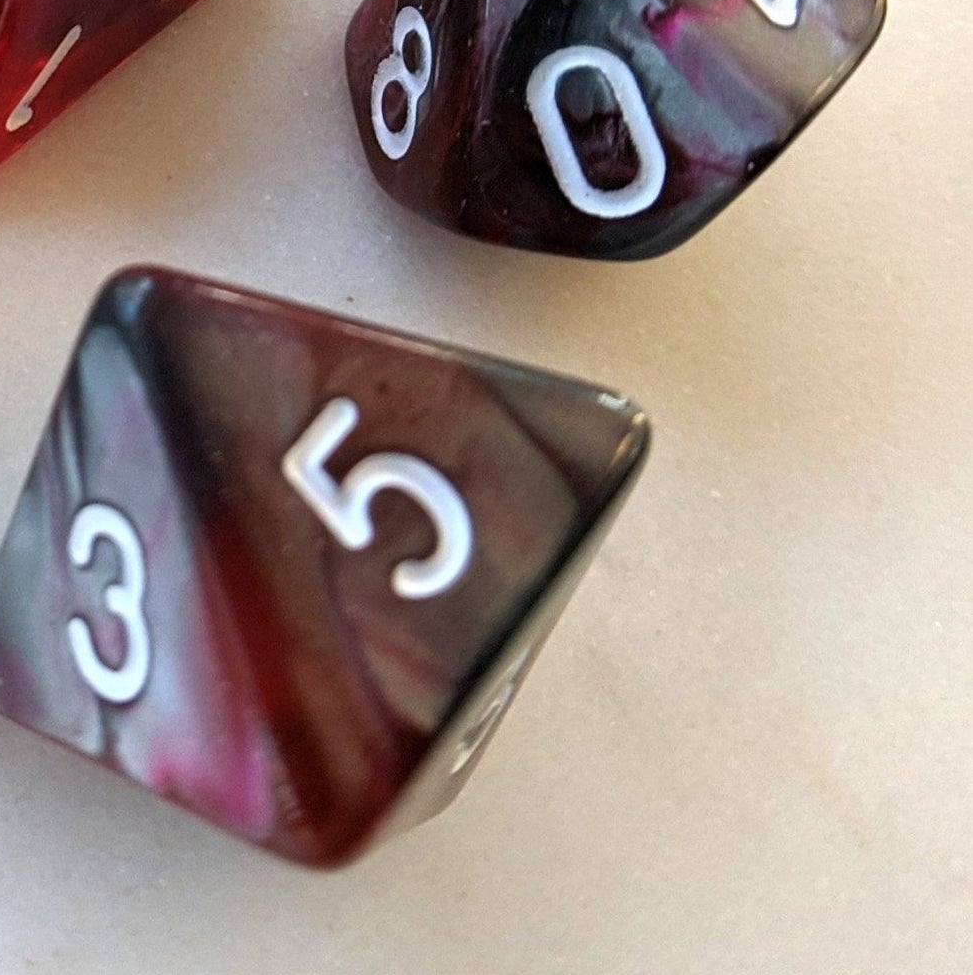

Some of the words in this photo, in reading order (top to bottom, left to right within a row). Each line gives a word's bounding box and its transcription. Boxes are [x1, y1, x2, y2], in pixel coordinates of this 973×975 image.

[5, 24, 83, 132] 1
[371, 5, 432, 160] 8
[525, 44, 667, 220] 0
[282, 396, 474, 601] 5
[67, 502, 151, 704] 3
